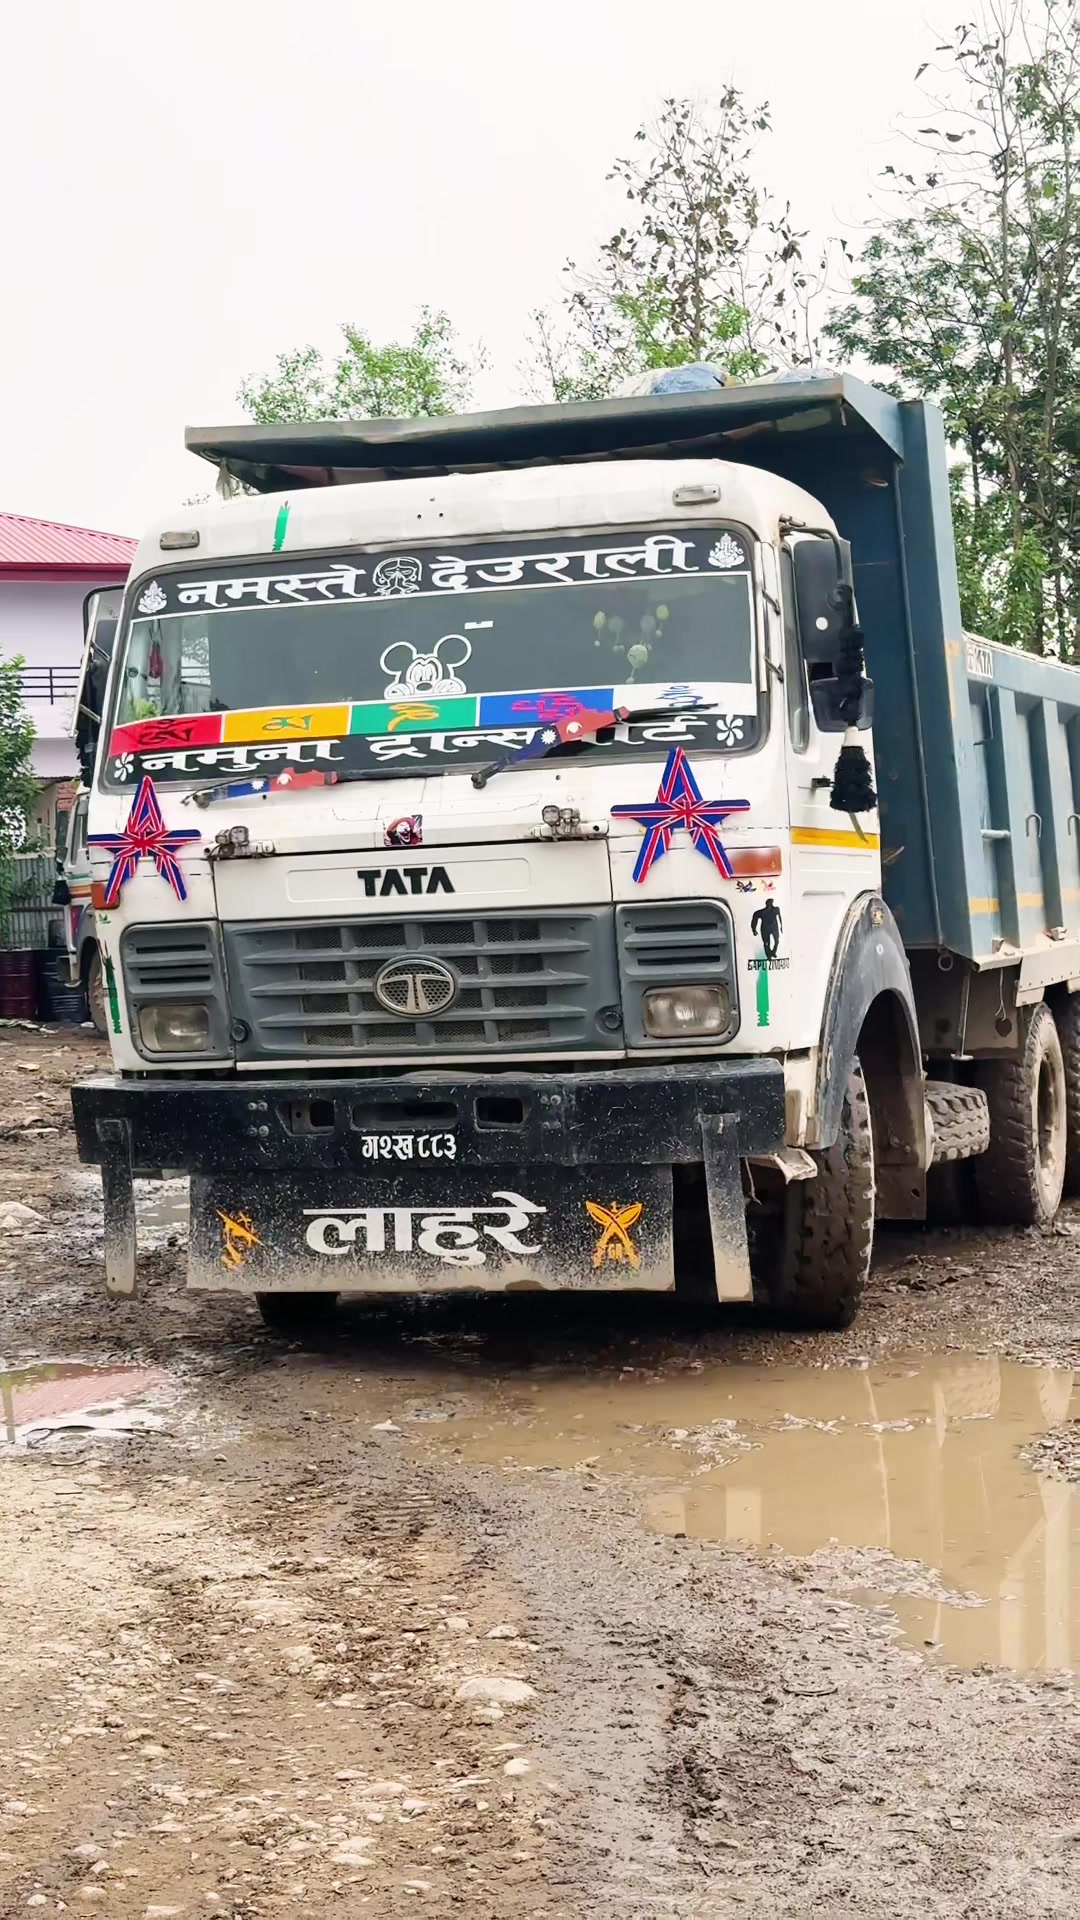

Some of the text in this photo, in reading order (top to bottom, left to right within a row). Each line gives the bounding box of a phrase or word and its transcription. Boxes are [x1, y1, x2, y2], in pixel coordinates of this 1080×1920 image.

[176, 535, 699, 606] नमस्ते देउराली
[139, 739, 345, 772] नमुना
[357, 866, 455, 896] TATA
[416, 1133, 457, 1160] ८८३
[303, 1191, 547, 1266] लाहुरे
